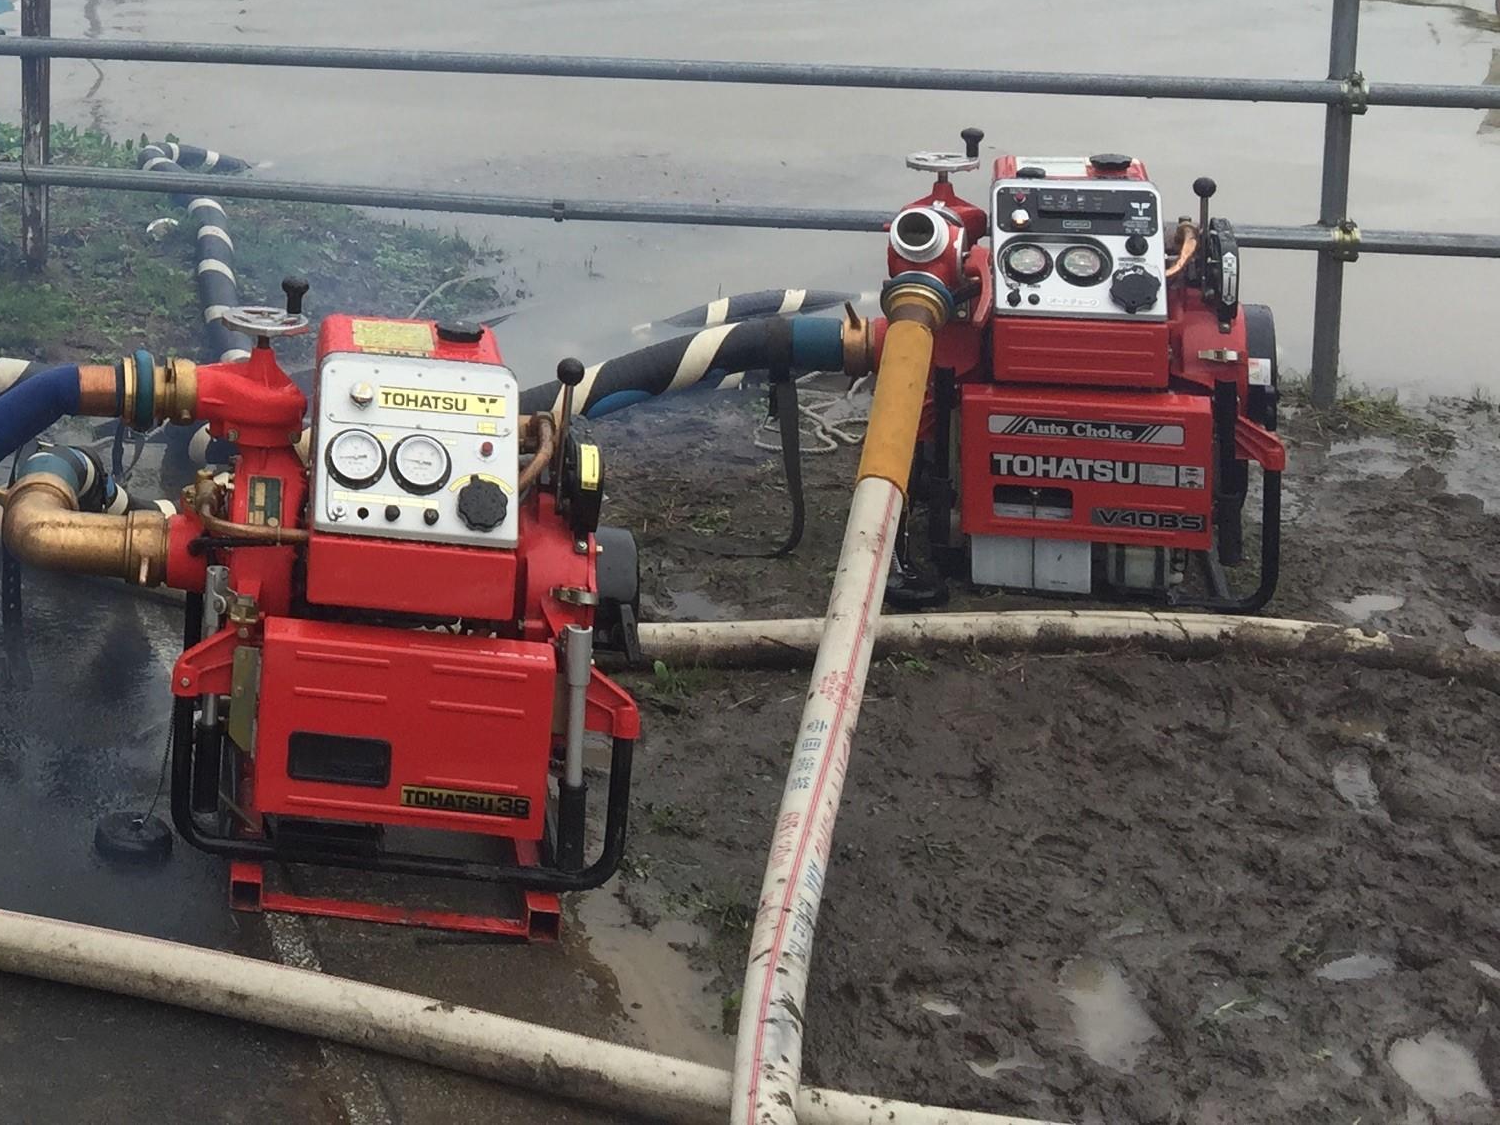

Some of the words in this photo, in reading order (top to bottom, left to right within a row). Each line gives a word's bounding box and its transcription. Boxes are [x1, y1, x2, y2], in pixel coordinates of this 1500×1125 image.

[381, 391, 468, 412] TOHATSU
[1024, 420, 1068, 436] Auto
[1072, 423, 1133, 440] Choke
[993, 454, 1136, 484] TOHATSU
[1097, 508, 1204, 531] V40BS
